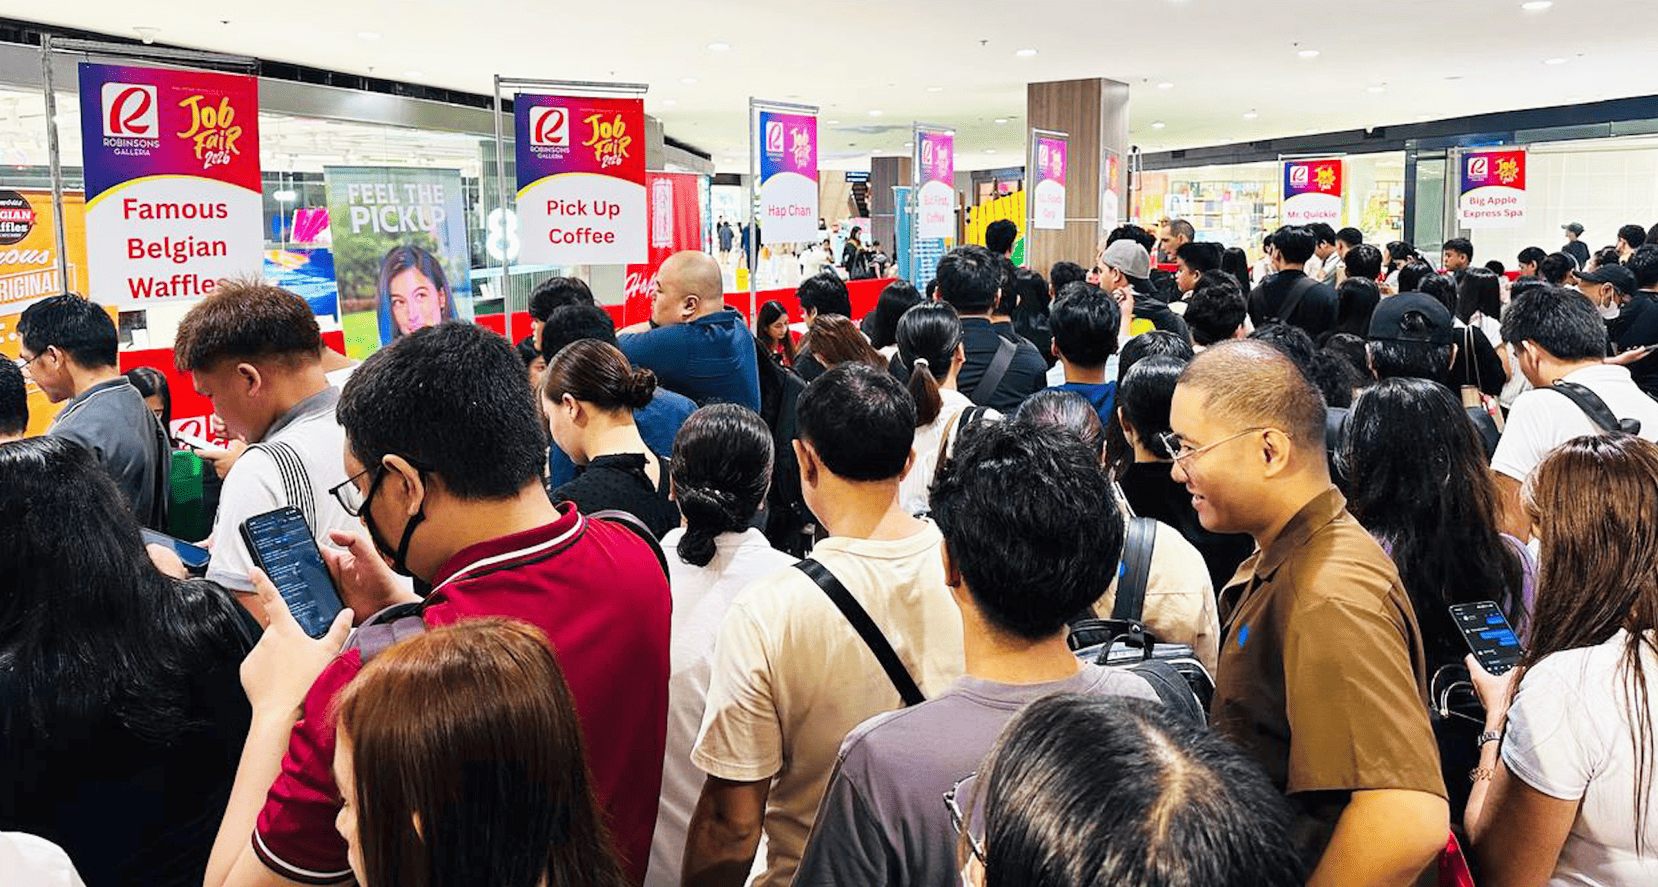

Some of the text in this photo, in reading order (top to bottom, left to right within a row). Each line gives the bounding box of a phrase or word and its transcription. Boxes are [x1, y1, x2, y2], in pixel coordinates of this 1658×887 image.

[177, 95, 234, 138] Job
[582, 114, 626, 146] Job
[103, 138, 160, 148] ROBINSONS
[114, 148, 151, 156] GALLERIA
[204, 151, 230, 169] 2026
[348, 184, 444, 205] FEEL THE
[1469, 196, 1517, 206] Big Apple
[123, 198, 228, 220] Famous
[547, 199, 620, 220] Pick Up
[768, 204, 811, 219] Hap Chan
[1287, 211, 1337, 219] Mr. Quickie
[1463, 208, 1523, 218] Express Spa
[351, 205, 447, 234] PICKUP
[549, 227, 615, 244] Coffee
[127, 235, 227, 264] Belgian
[128, 273, 216, 299] Waffle
